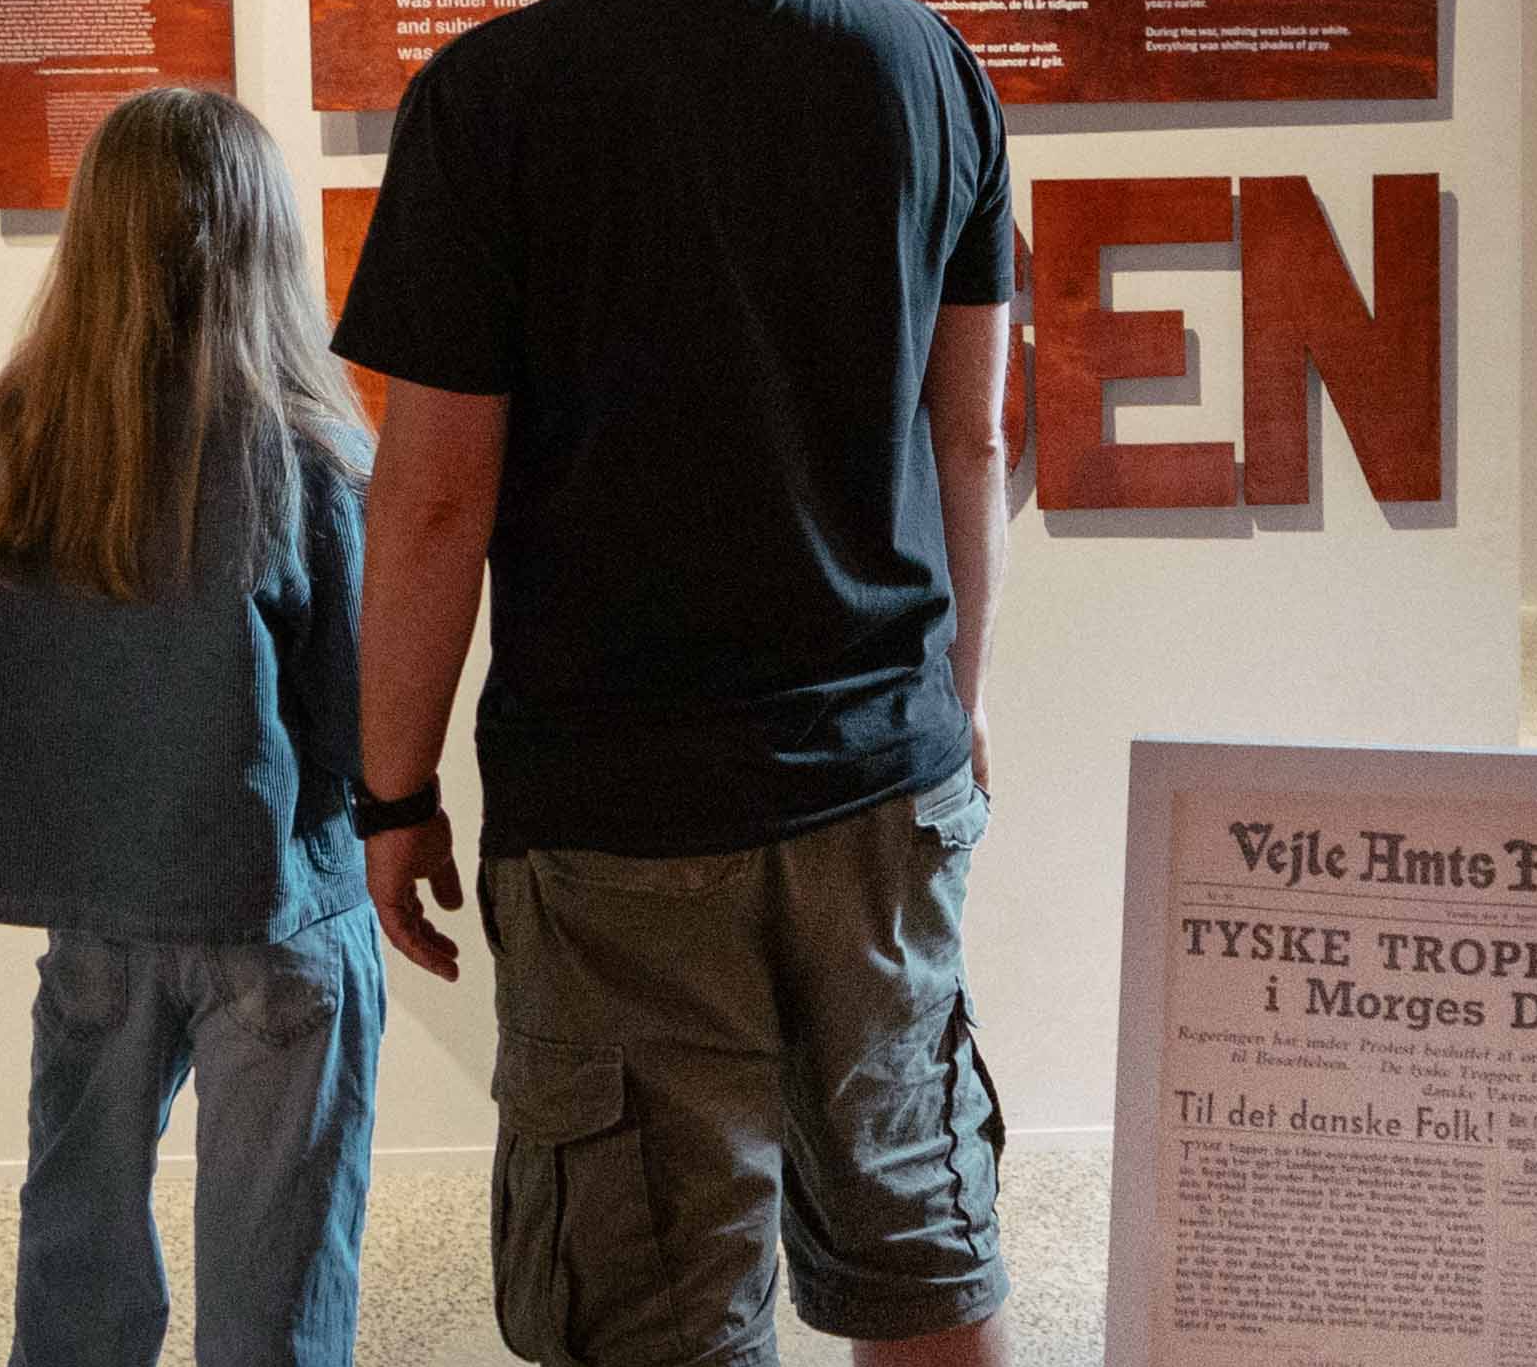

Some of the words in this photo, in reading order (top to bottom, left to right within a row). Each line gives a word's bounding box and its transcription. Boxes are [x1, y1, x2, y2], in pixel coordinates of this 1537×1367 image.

[397, 18, 431, 34] and
[398, 47, 433, 61] was
[1229, 822, 1348, 887] Vejle
[1359, 831, 1497, 890] Amts
[1182, 918, 1351, 967] TYSKE
[1264, 975, 1280, 1012] i
[1305, 977, 1486, 1031] Morges
[1174, 1090, 1214, 1124] Til
[1228, 1094, 1277, 1128] det
[1290, 1098, 1402, 1136] danske
[1415, 1105, 1494, 1144] Folk!
